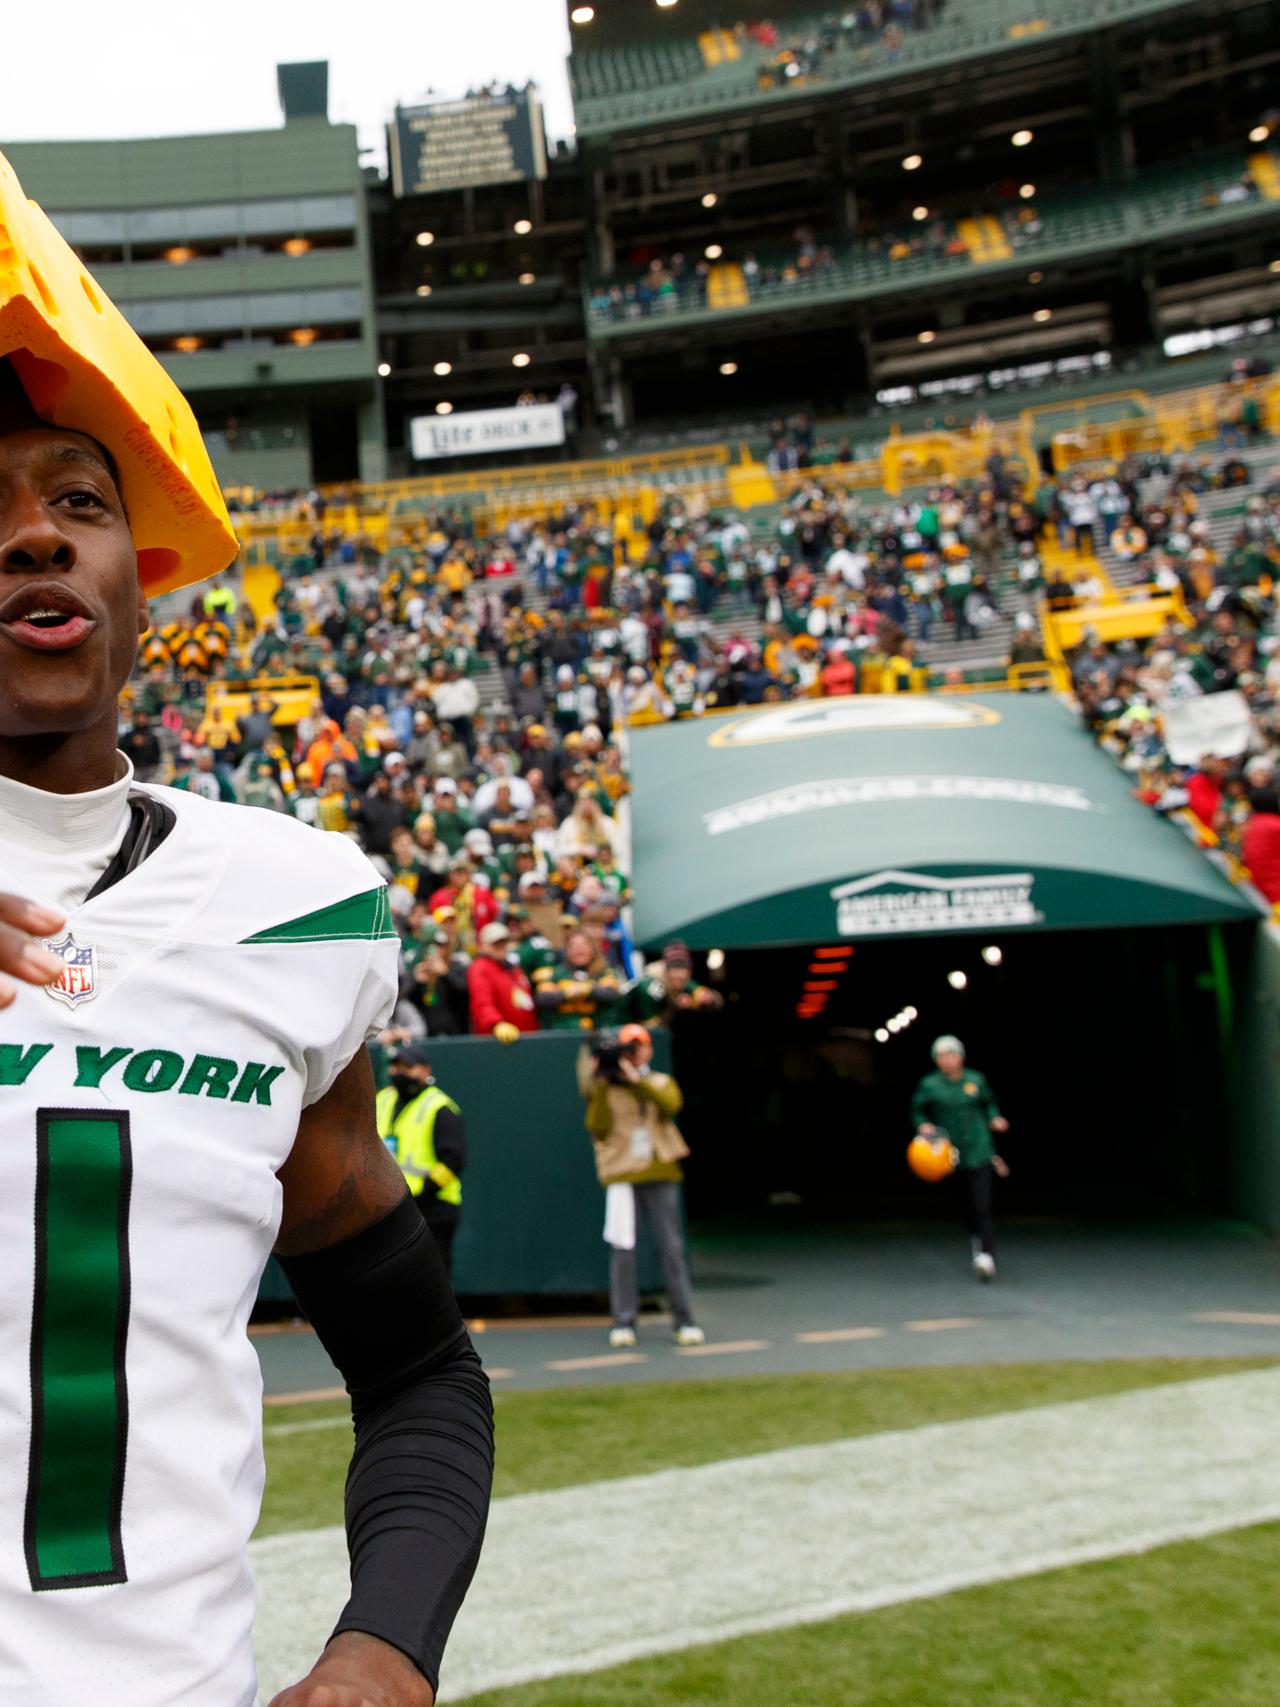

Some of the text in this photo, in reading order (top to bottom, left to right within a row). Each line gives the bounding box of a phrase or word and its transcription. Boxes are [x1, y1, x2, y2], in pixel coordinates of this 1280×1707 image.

[54, 967, 91, 994] NFL
[73, 1046, 285, 1106] YORK
[23, 1107, 133, 1592] 1
